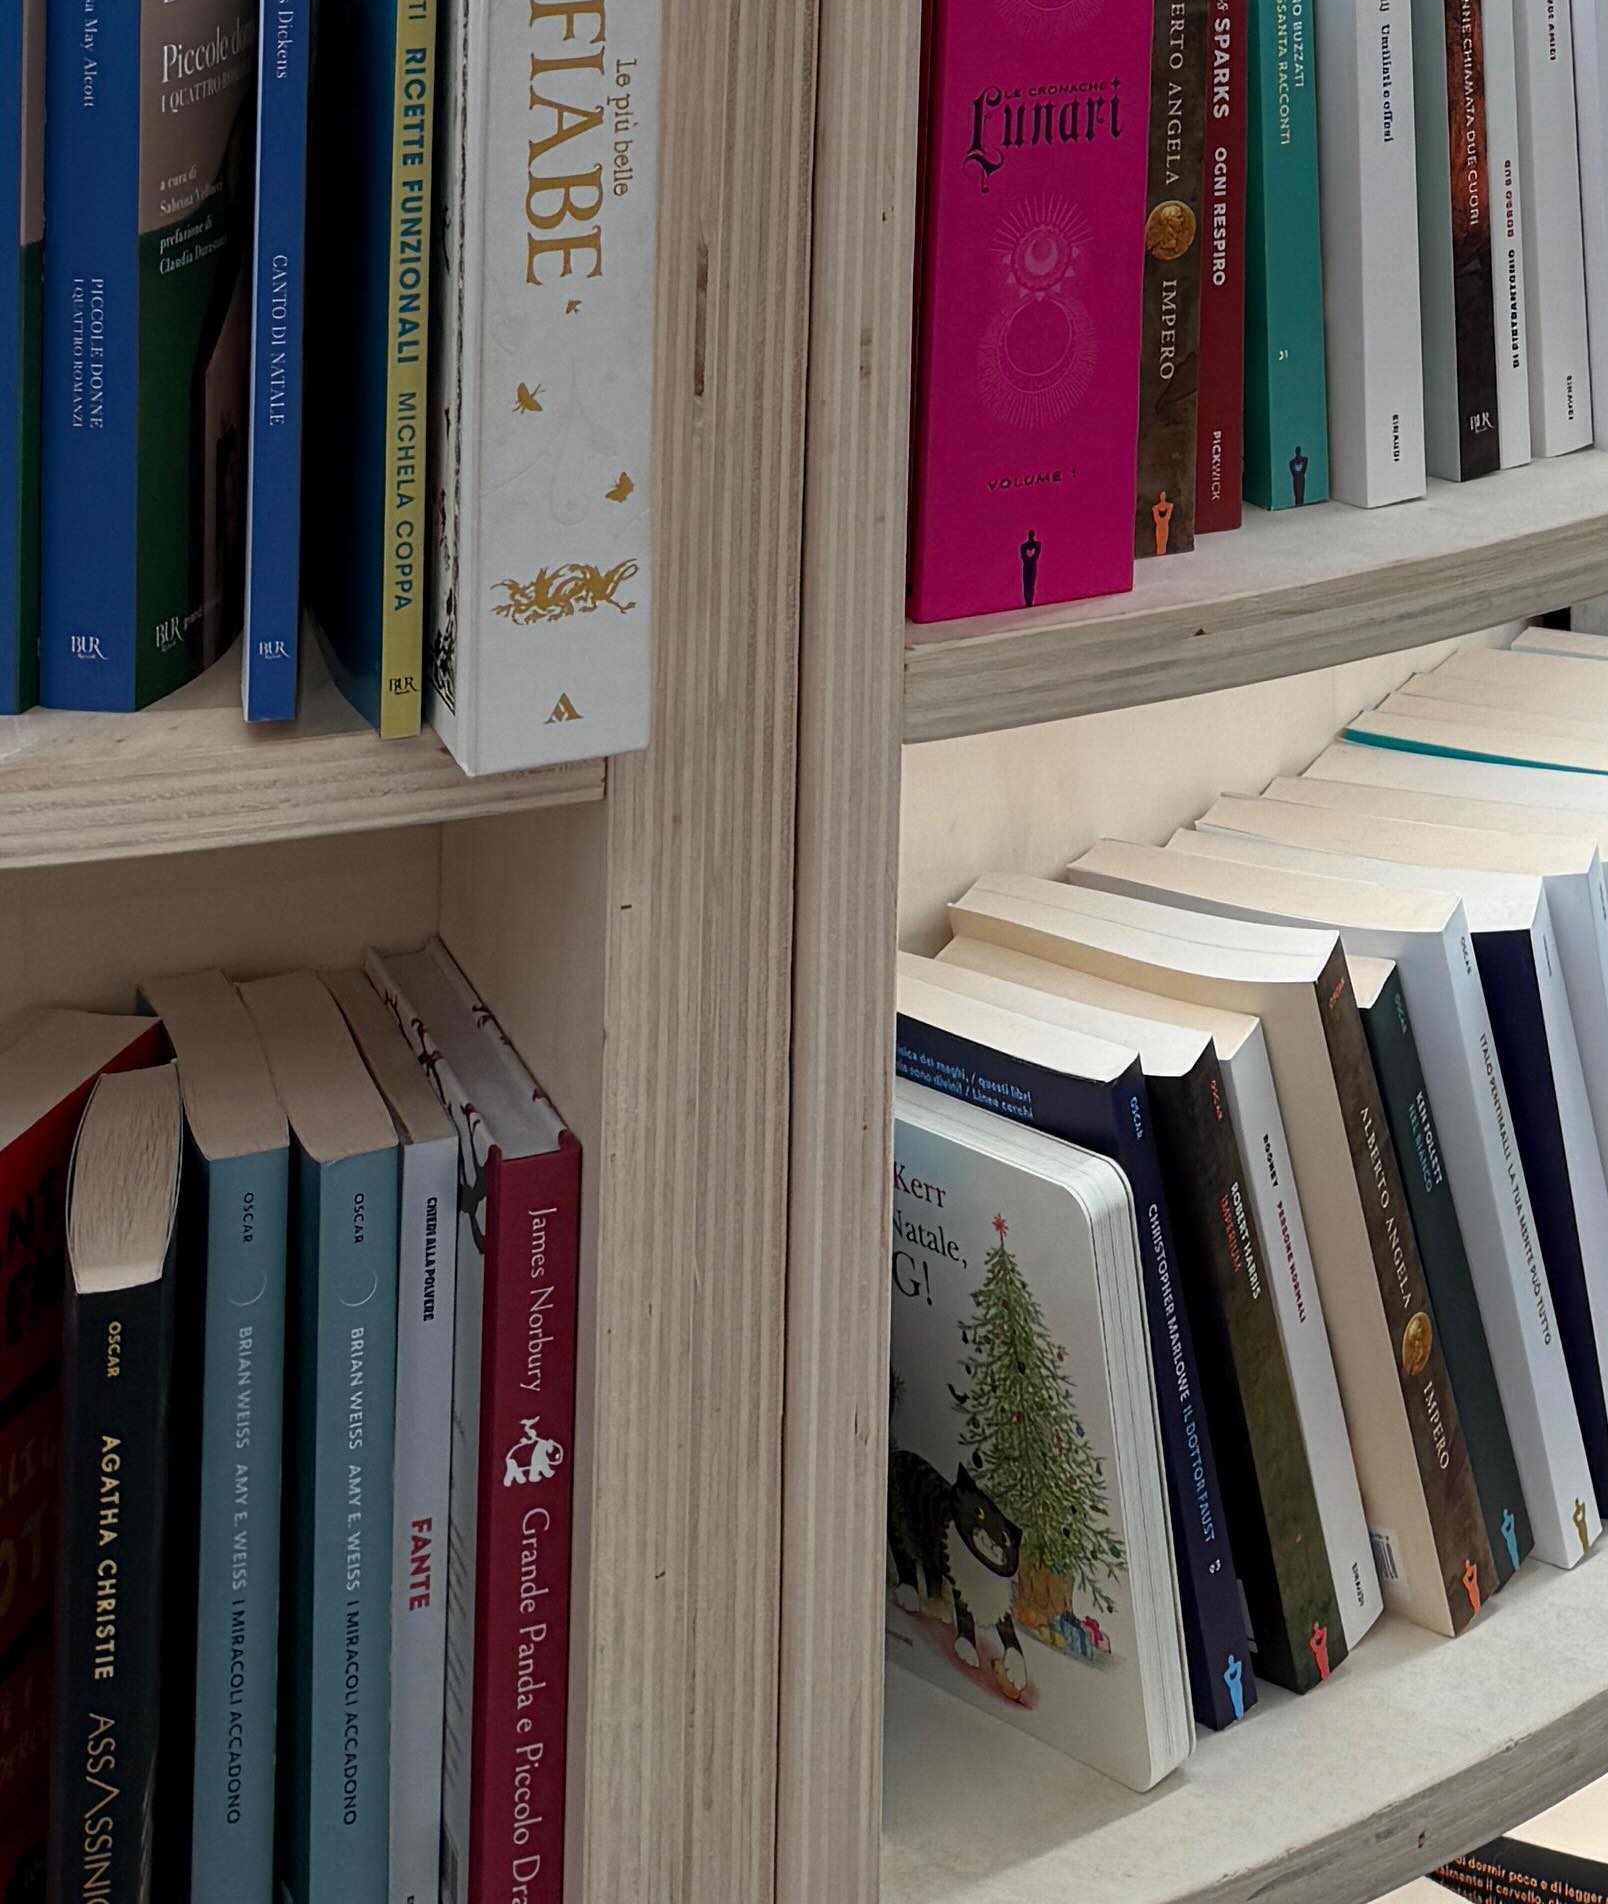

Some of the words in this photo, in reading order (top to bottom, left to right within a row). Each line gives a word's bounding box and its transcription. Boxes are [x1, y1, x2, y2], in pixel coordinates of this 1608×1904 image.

[277, 11, 294, 78] Dickens
[615, 59, 637, 87] Le
[1213, 18, 1230, 118] SPARKS
[403, 48, 427, 166] RICETTE
[609, 93, 638, 133] più
[1166, 82, 1182, 184] ANGELA
[613, 140, 633, 196] belle
[1214, 147, 1227, 196] OGNI
[397, 180, 423, 363] FUNZIONALI
[1213, 203, 1226, 285] RESPIRO
[91, 279, 104, 357] PICCOLE
[272, 255, 287, 319] CANTO
[271, 326, 286, 345] DI
[1160, 280, 1177, 379] IMPERO
[90, 364, 103, 428] DONNE
[270, 353, 285, 425] NATALE
[396, 392, 416, 509] MICHELA
[394, 520, 414, 611] COPPA
[354, 1193, 364, 1243] OSCAR
[528, 1208, 557, 1278] James
[1231, 1182, 1249, 1240] ROBERT
[1244, 1242, 1261, 1299] HARRIS
[1360, 1107, 1389, 1208] ALBERTO
[1386, 1217, 1411, 1308] ANGELA
[520, 1286, 554, 1391] Norbury
[1149, 1204, 1174, 1316] CHRISTOPHER
[1168, 1316, 1190, 1402] MARLOWE
[107, 1321, 121, 1377] OSCAR
[350, 1327, 364, 1386] BRIAN
[349, 1391, 363, 1449] WEISS
[1423, 1381, 1449, 1469] IMPERO
[99, 1436, 121, 1546] AGATHA
[348, 1512, 361, 1527] E.
[349, 1465, 361, 1505] AMY
[347, 1532, 360, 1590] WEISS
[409, 1518, 432, 1611] FANTE
[520, 1508, 550, 1613] Grande
[94, 1559, 117, 1679] CHRISTIE
[345, 1611, 359, 1706] MIRACOLI
[517, 1624, 547, 1710] Panda
[516, 1718, 532, 1733] e
[343, 1713, 358, 1825] ACCADONO
[513, 1743, 543, 1845] Piccolo
